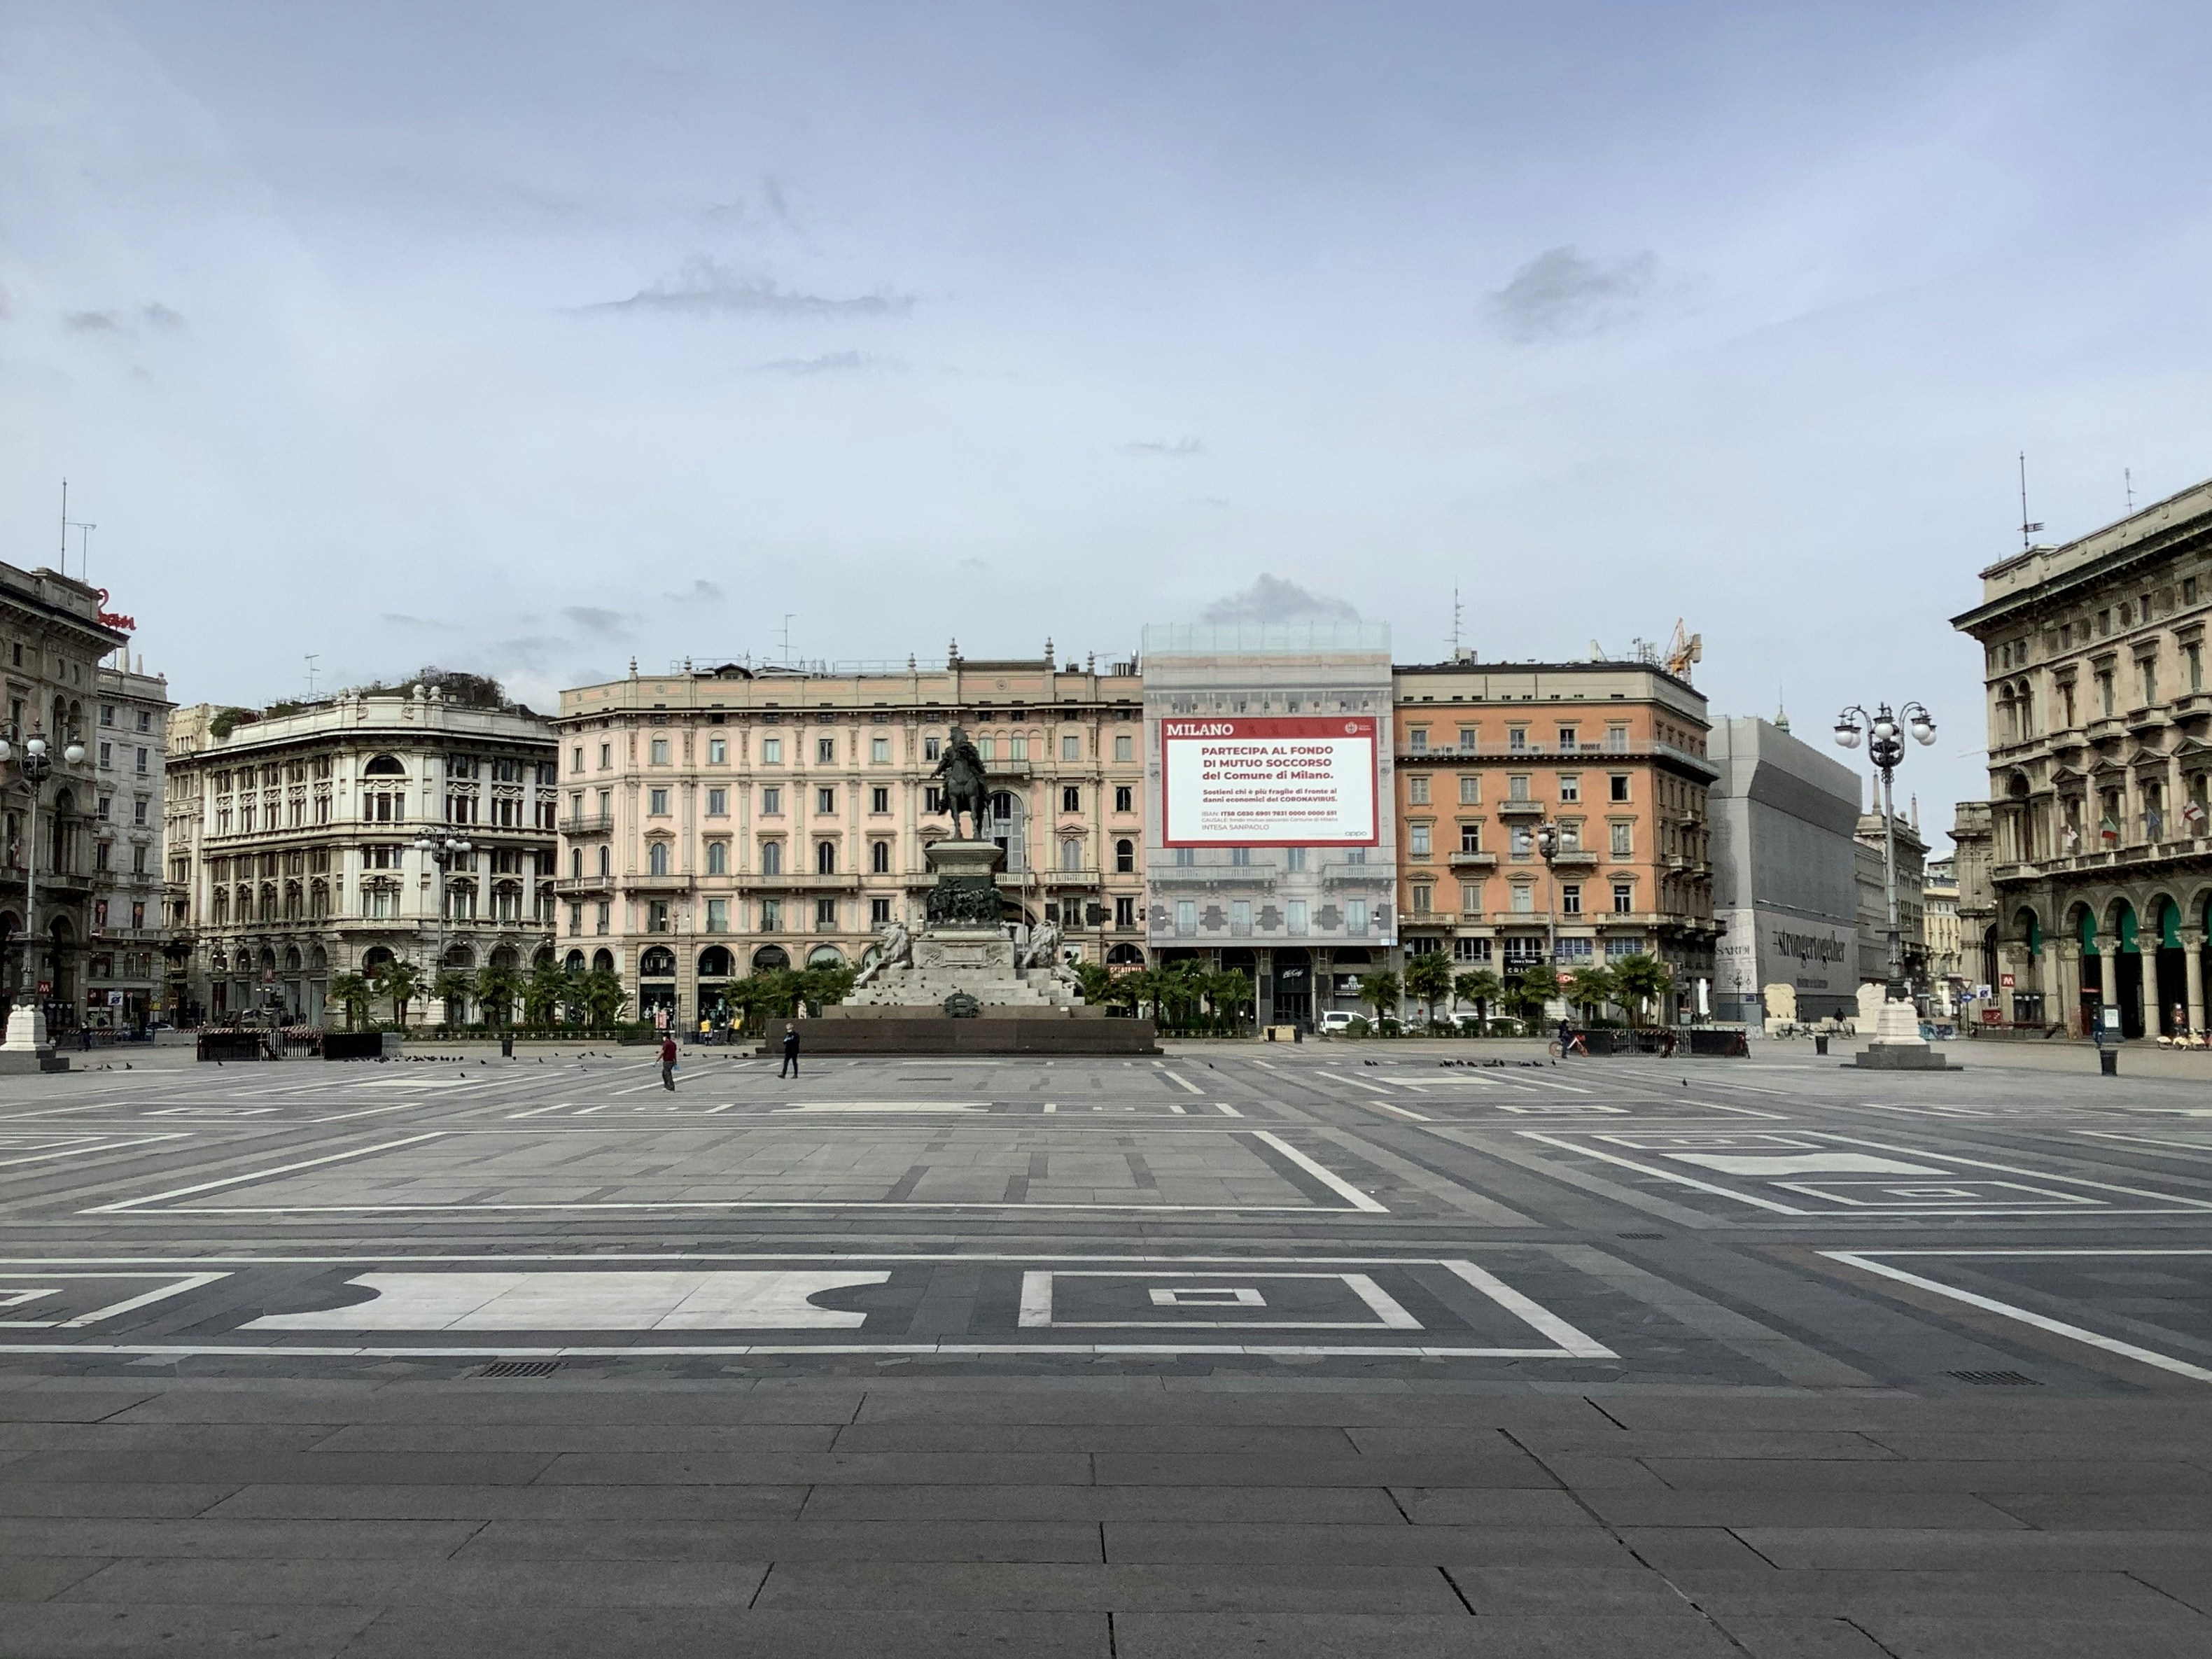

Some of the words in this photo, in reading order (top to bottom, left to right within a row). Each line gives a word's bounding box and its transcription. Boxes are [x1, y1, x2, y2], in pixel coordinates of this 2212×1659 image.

[1167, 724, 1234, 736] MILANO
[1202, 747, 1268, 755] PARTECIPA
[1291, 746, 1334, 755] FONDO
[1219, 759, 1263, 767] MUTUO
[1266, 758, 1332, 767] SOCCORSO
[1203, 771, 1220, 780] del
[1224, 771, 1273, 780] Comune
[1276, 771, 1287, 779] di
[1291, 770, 1334, 779] Milano.
[2003, 976, 2014, 985] M
[39, 984, 50, 993] M
